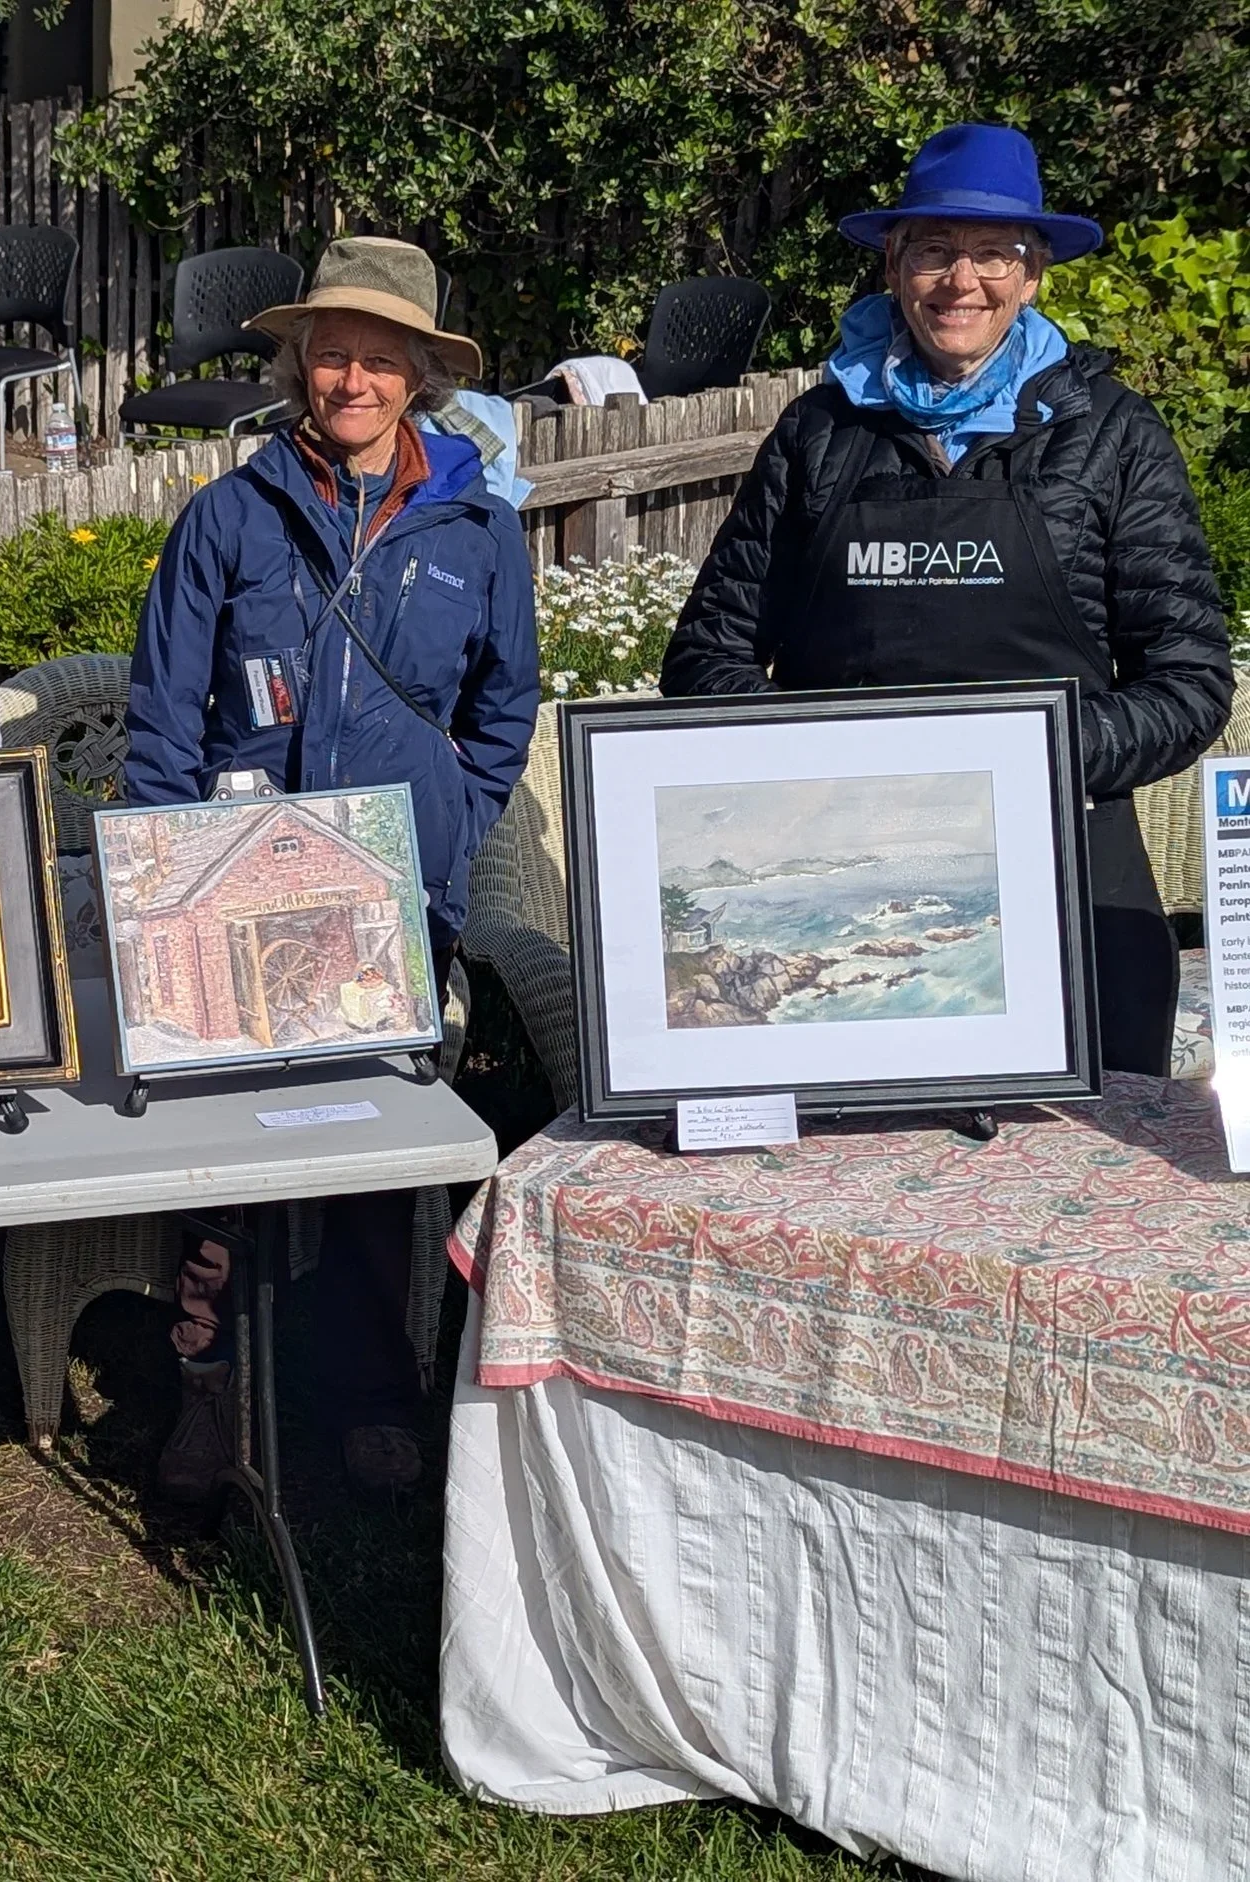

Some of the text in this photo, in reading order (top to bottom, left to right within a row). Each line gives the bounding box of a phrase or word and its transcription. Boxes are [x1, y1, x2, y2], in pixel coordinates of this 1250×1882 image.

[847, 540, 1005, 575] MBPAPA
[847, 577, 881, 586] Monterey
[882, 577, 898, 587] Bay
[917, 576, 928, 585] Air
[929, 576, 959, 585] Painters
[959, 575, 1005, 585] Association
[1221, 937, 1245, 948] Early
[1223, 967, 1235, 976] its
